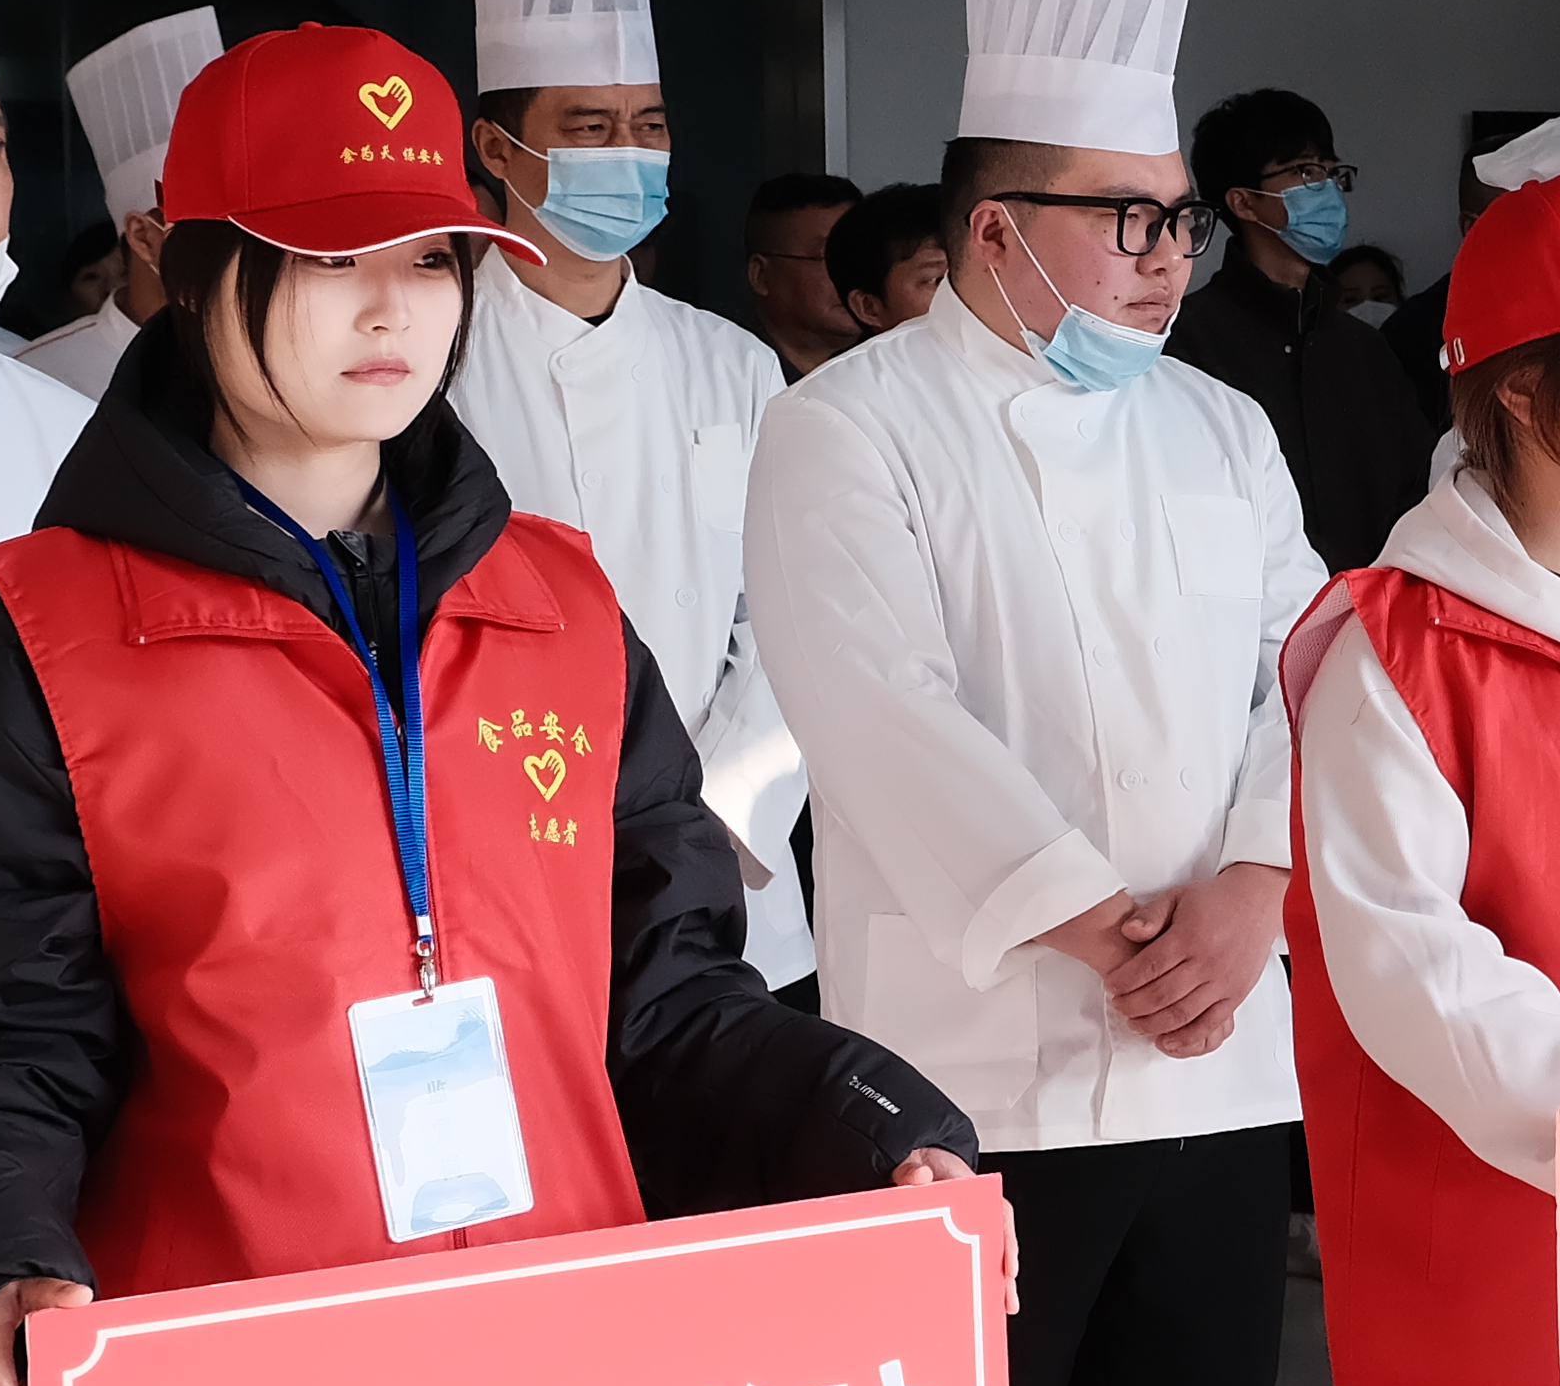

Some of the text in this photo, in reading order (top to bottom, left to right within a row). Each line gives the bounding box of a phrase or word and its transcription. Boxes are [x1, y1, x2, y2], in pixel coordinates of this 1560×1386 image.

[477, 709, 593, 757] 食品安全
[529, 813, 578, 847] 志愿者
